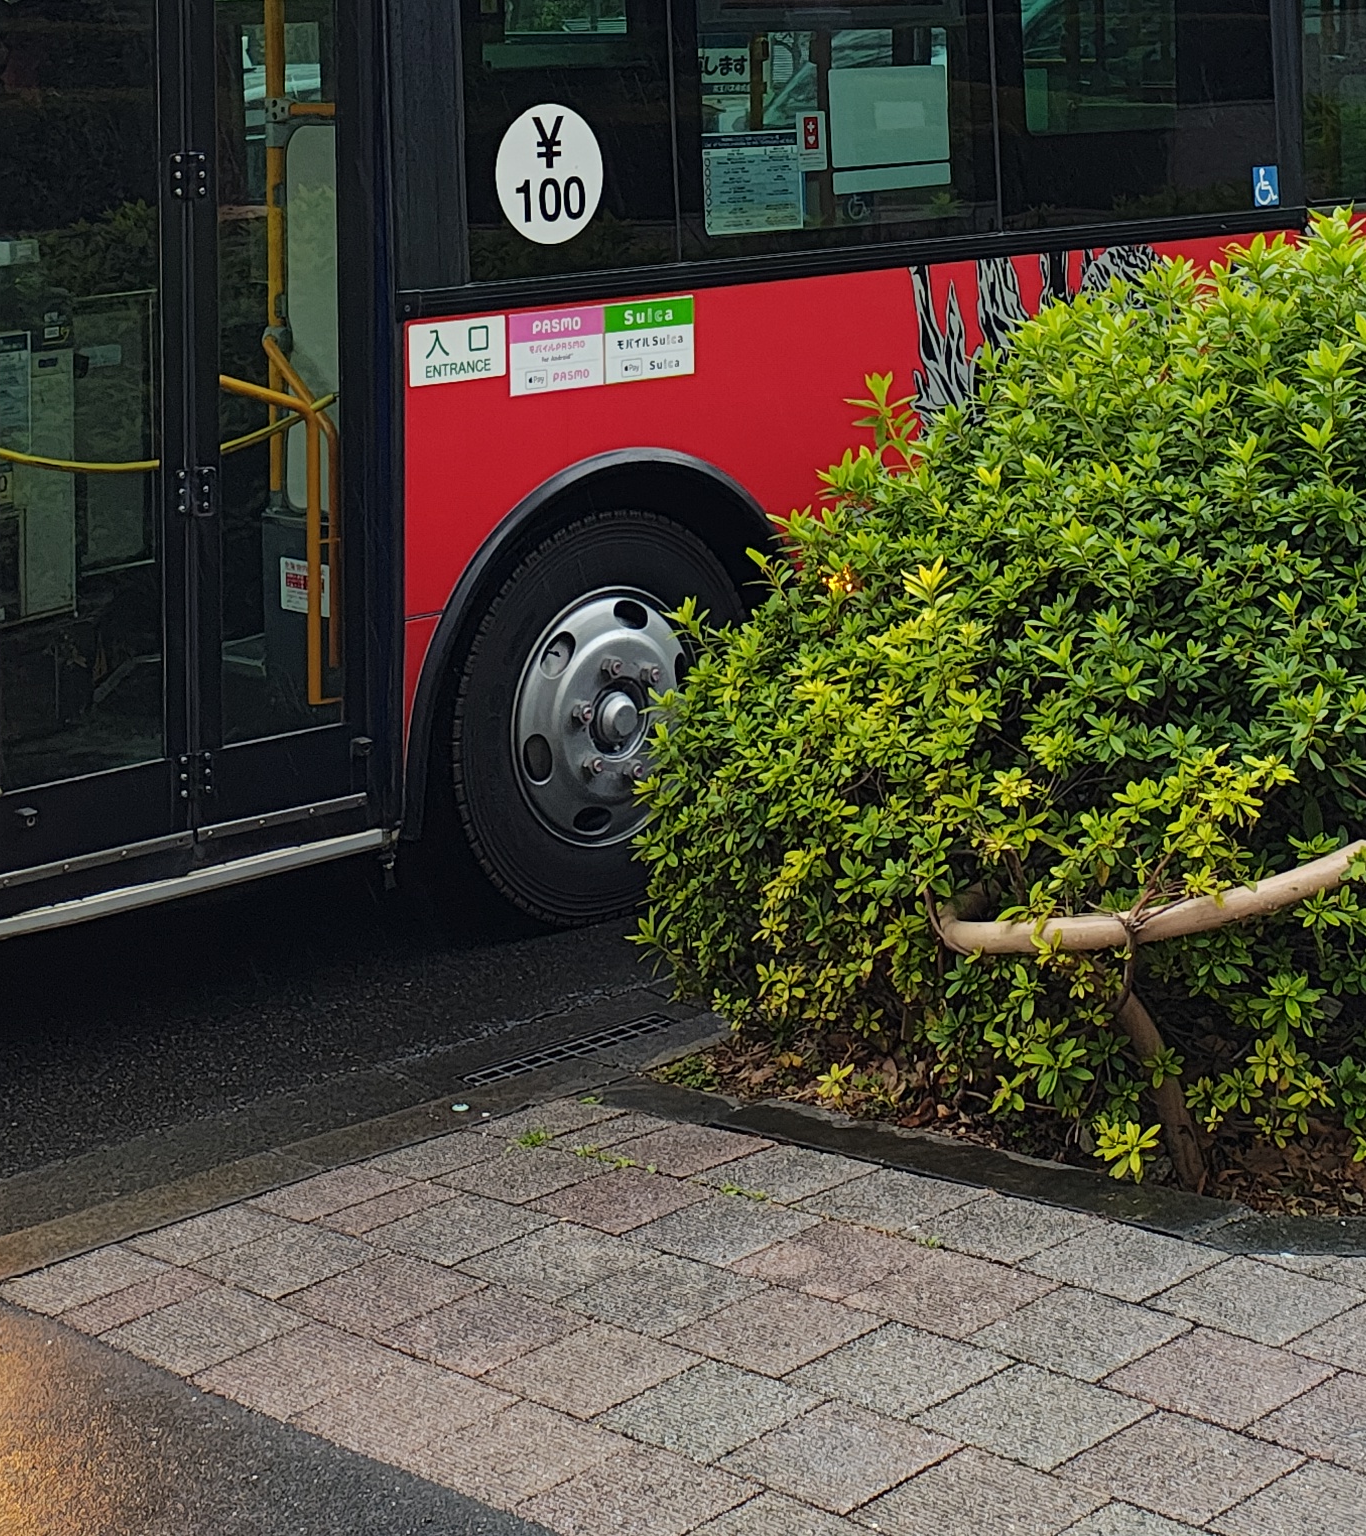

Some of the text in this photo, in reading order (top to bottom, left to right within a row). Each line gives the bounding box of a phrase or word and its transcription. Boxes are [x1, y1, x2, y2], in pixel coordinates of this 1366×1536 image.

[699, 55, 748, 76] します
[515, 175, 587, 224] 100
[532, 316, 583, 335] PASMO
[624, 308, 674, 326] Suica
[425, 324, 489, 360] 入口
[425, 358, 492, 379] ENTRANCE
[649, 357, 680, 371] Suica
[552, 368, 590, 383] PASMO
